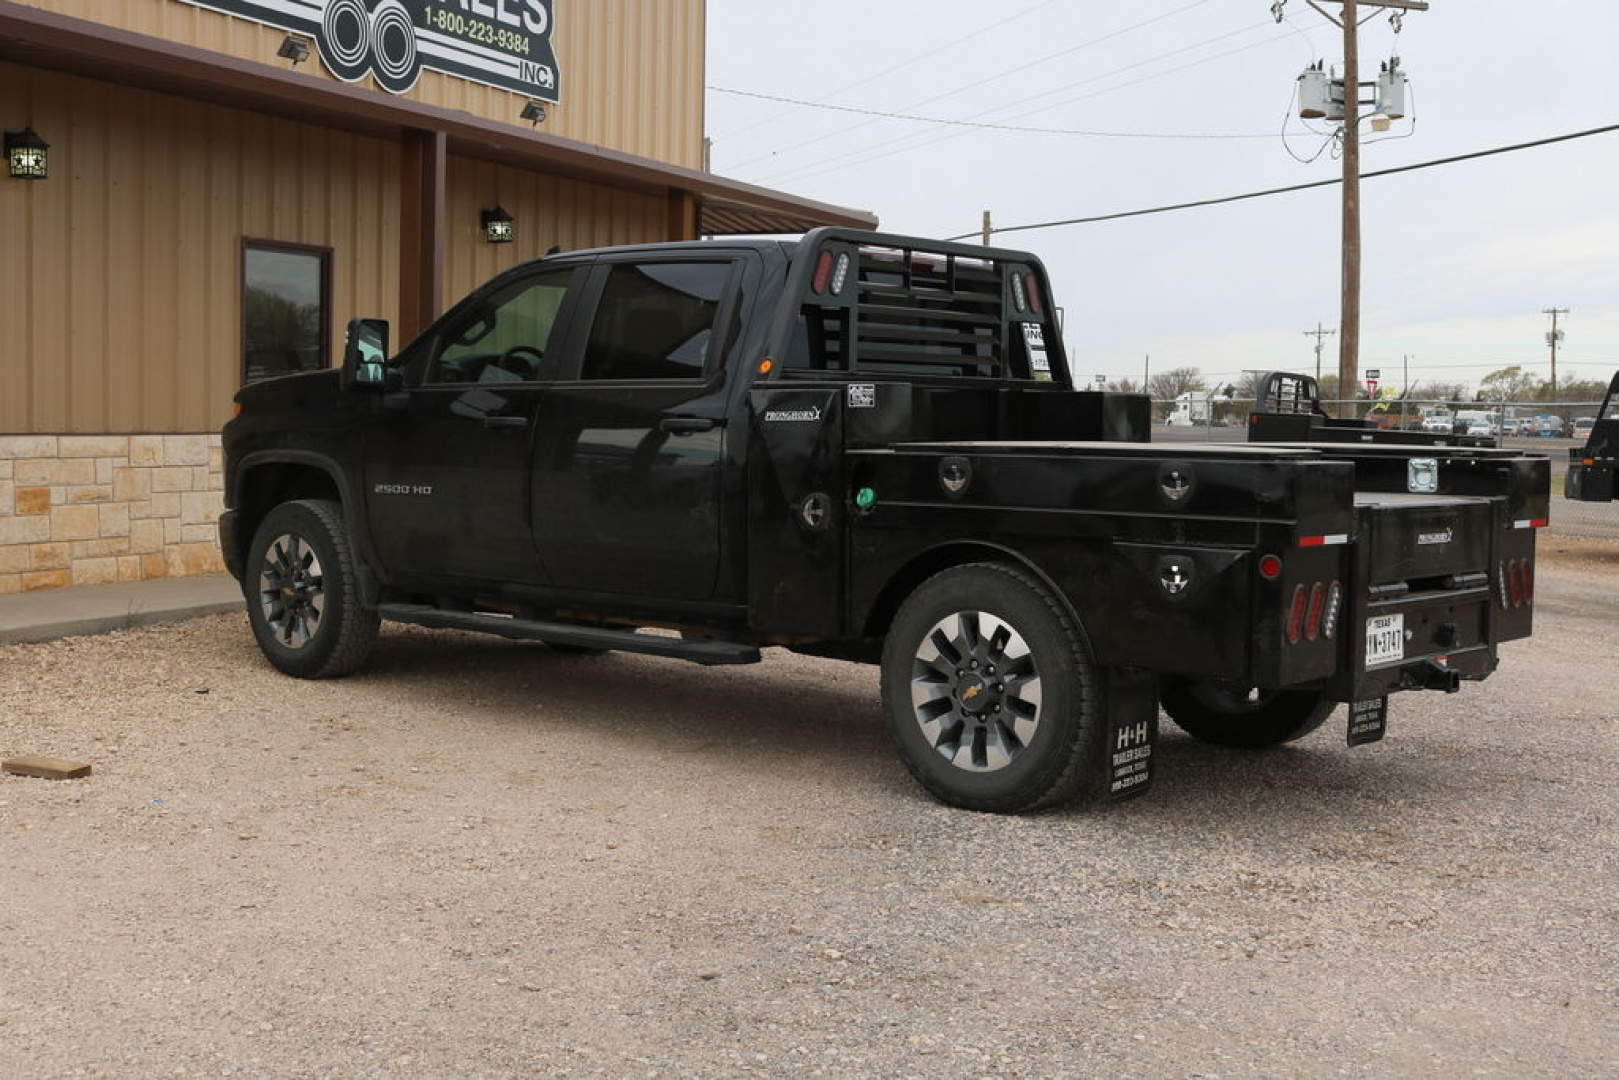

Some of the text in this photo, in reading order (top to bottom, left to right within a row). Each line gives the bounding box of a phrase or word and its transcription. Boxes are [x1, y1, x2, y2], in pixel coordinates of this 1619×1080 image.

[424, 5, 530, 55] 1-800-223-9384
[520, 60, 554, 88] INC.
[375, 484, 410, 494] 2500
